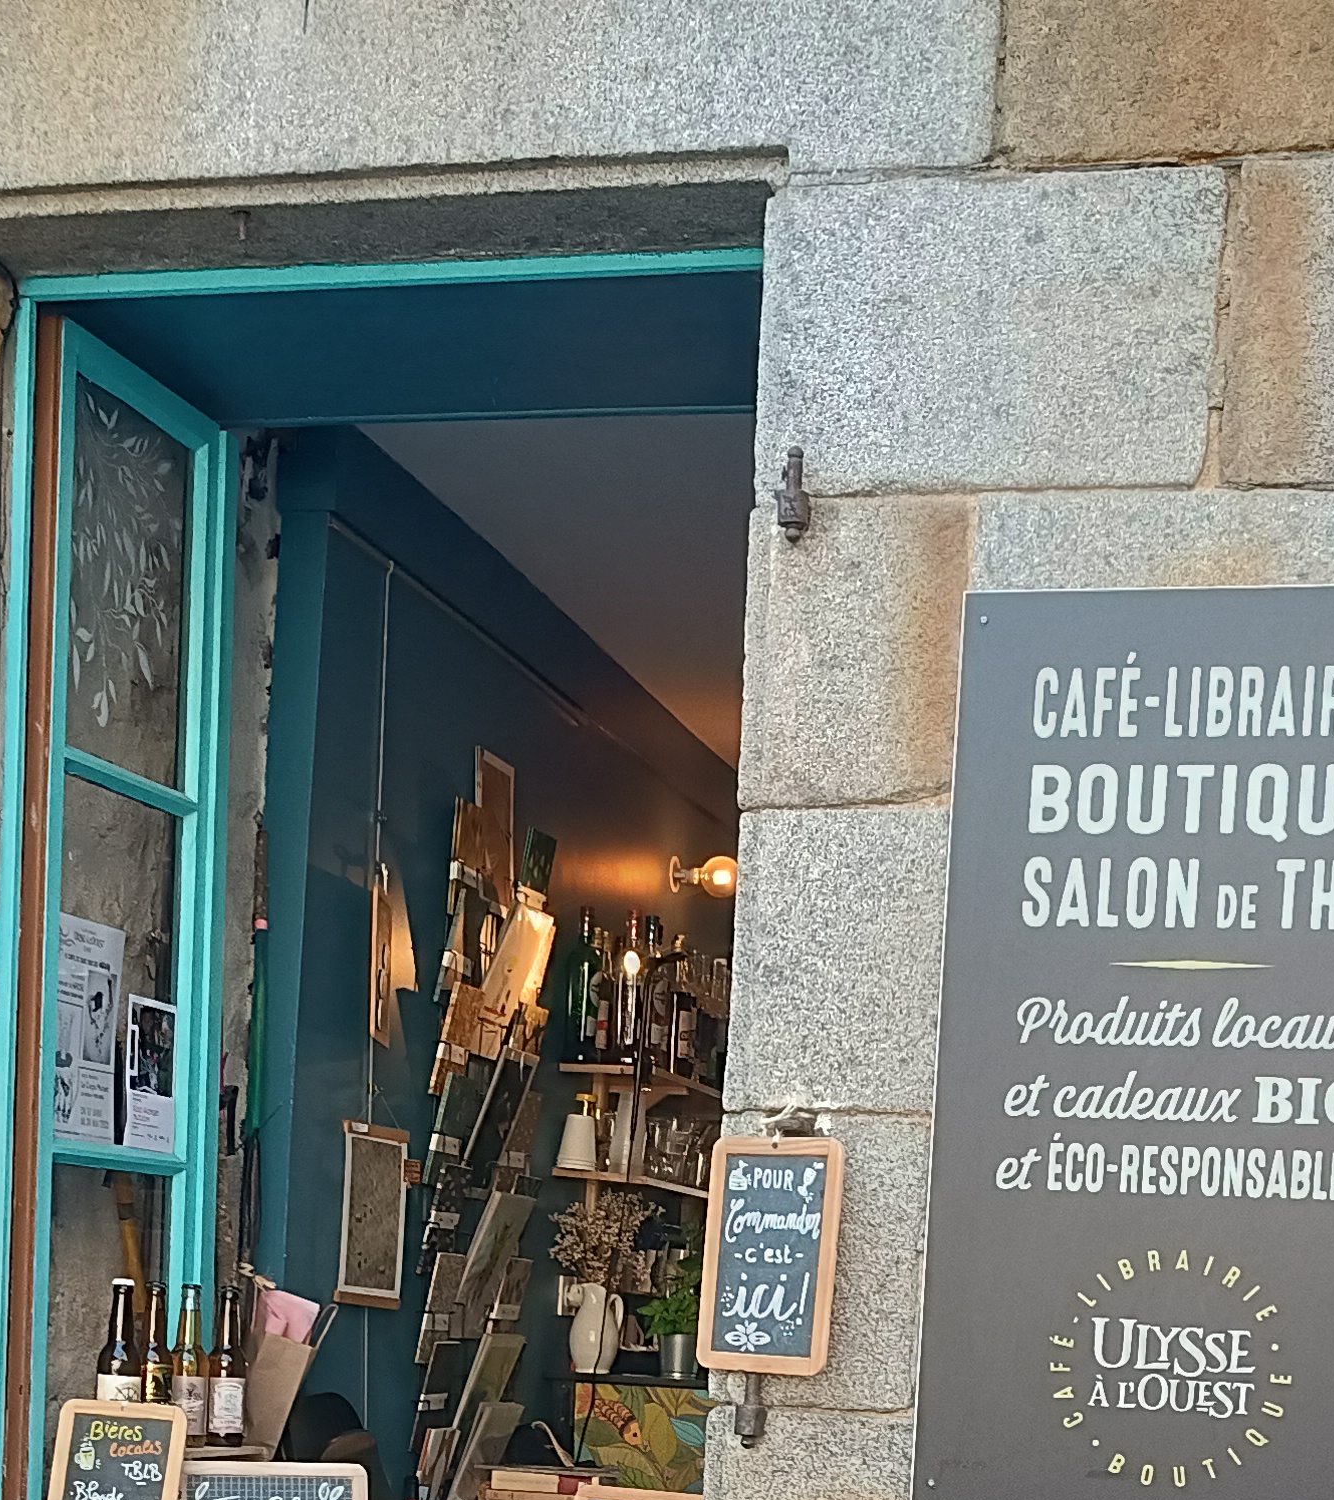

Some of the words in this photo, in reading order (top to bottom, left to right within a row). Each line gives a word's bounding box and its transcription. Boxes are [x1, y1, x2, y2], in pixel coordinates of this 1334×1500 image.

[1021, 856, 1200, 929] SALON
[1216, 884, 1259, 929] DE
[1017, 996, 1202, 1048] Produits
[1003, 1073, 1042, 1119] et
[1053, 1071, 1239, 1122] cadeaux
[753, 1166, 795, 1191] POUR
[996, 1150, 1041, 1191] et
[1091, 1316, 1257, 1379] ULYSSE
[1087, 1374, 1110, 1408] À
[1117, 1373, 1256, 1419] L'OUEST
[89, 1420, 143, 1441] Bières
[109, 1439, 163, 1457] locales
